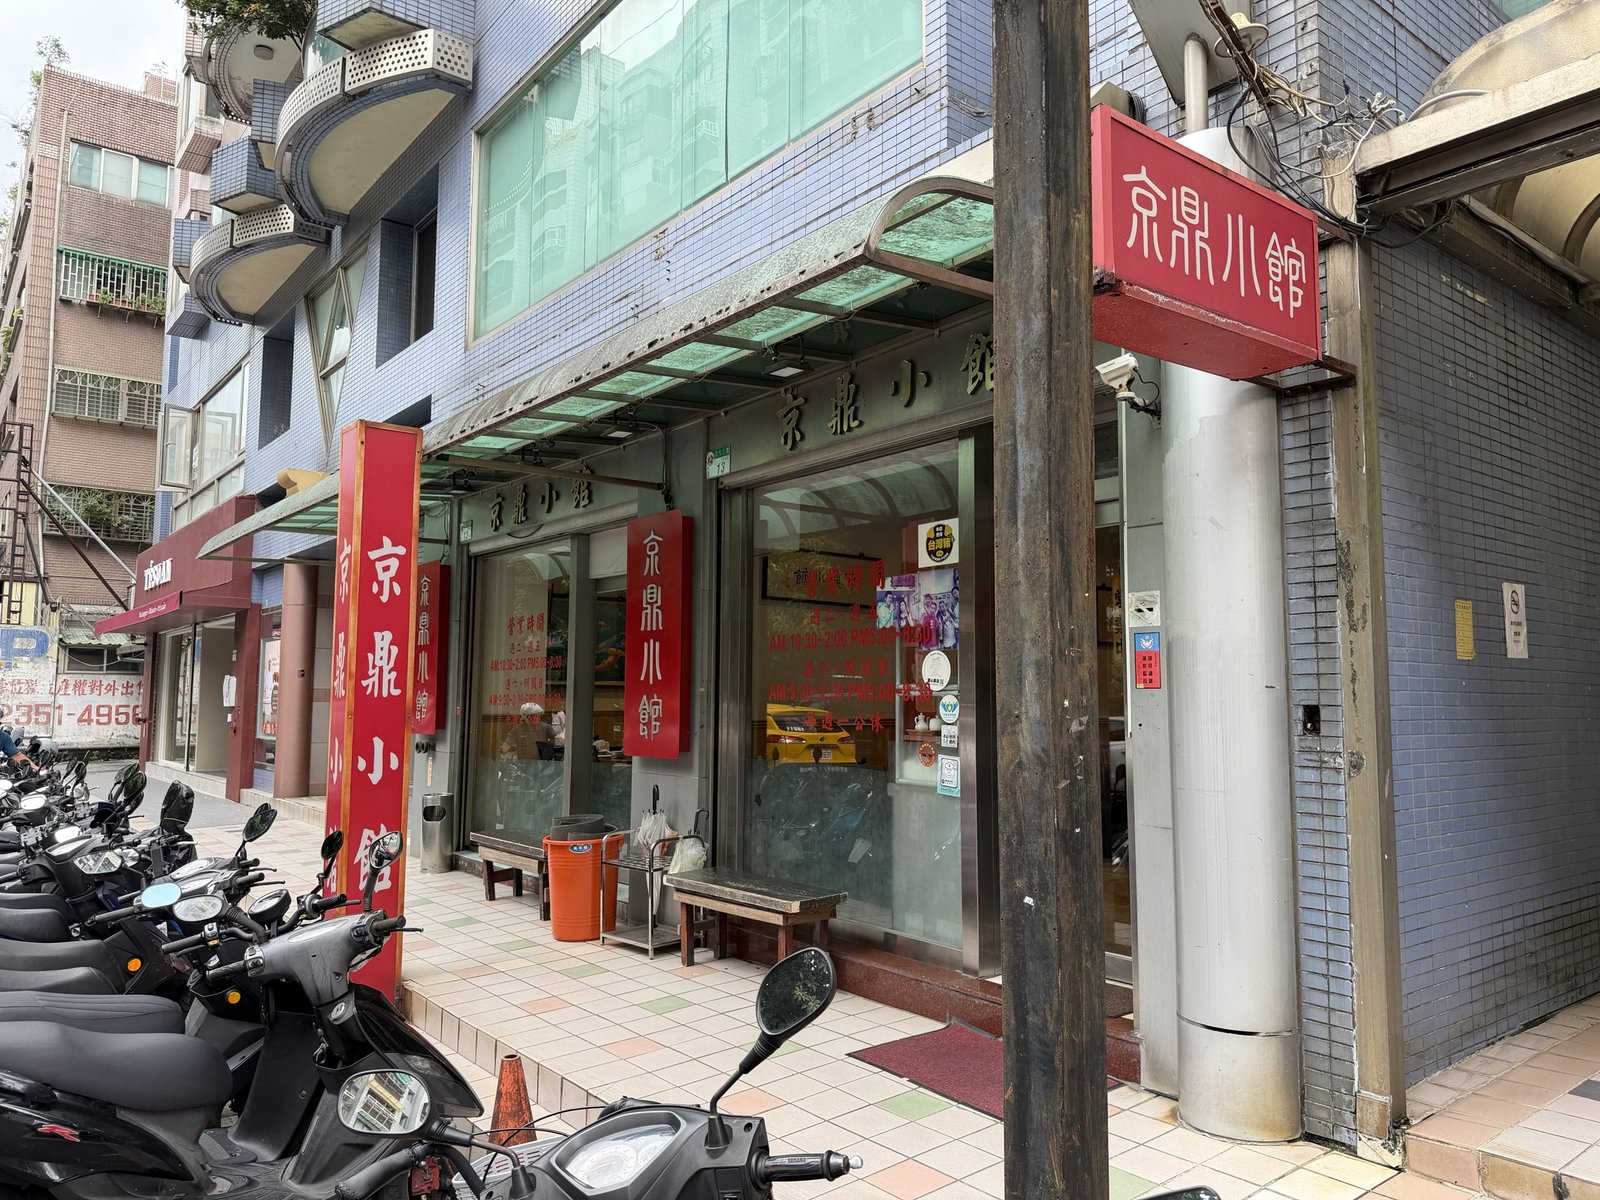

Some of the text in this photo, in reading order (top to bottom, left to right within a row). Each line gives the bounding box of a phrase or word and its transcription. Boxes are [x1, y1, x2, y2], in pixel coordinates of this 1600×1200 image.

[1122, 165, 1307, 319] 京鼎小館
[716, 461, 726, 475] 13
[415, 574, 432, 723] 京鼎小館
[639, 530, 664, 741] 京鼎小館
